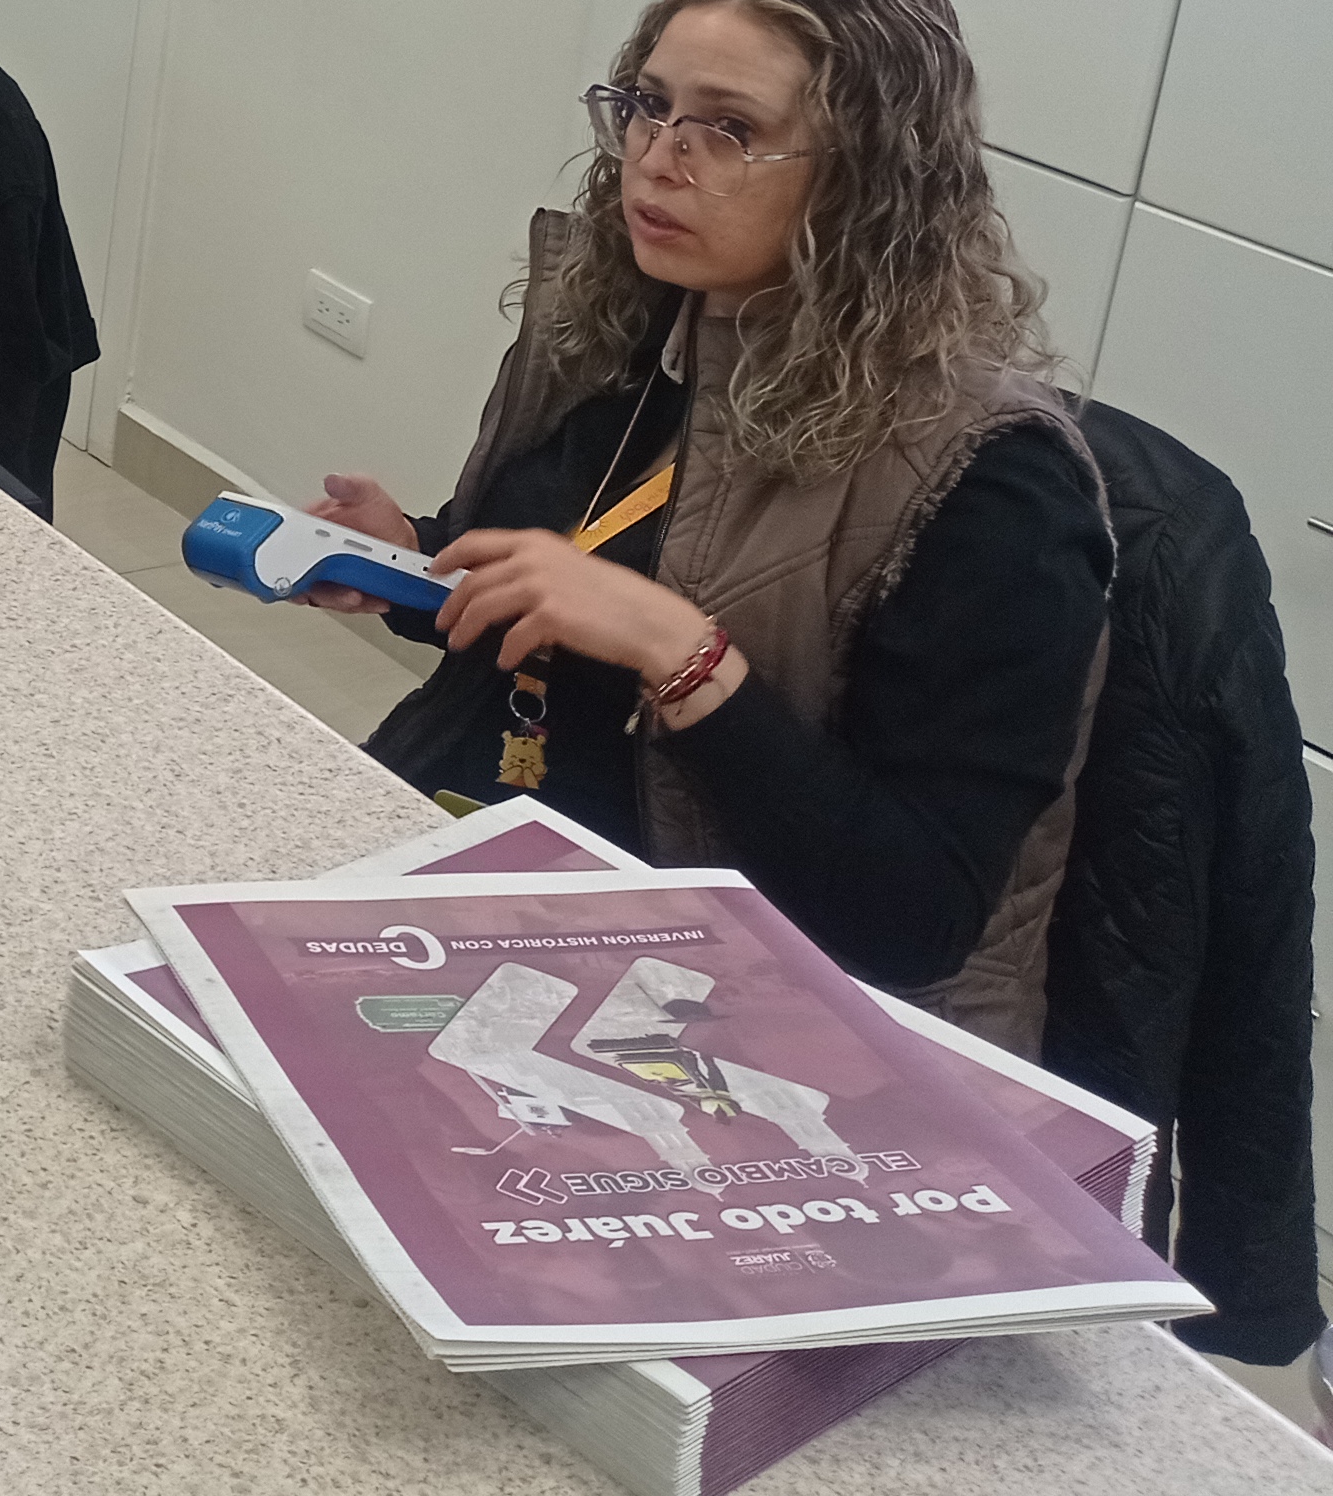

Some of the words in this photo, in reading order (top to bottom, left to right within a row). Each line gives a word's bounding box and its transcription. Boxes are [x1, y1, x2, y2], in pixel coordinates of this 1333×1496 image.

[306, 942, 408, 953] DEUDAS
[450, 940, 494, 950] CON
[497, 936, 599, 949] HISTÓRICA
[603, 930, 705, 946] INVERSIÓN
[694, 1156, 860, 1186] CAMBIO
[857, 1151, 922, 1172] EL
[561, 1169, 693, 1195] SIGUE
[889, 1185, 1012, 1216] Por
[720, 1198, 881, 1234] todo
[481, 1211, 715, 1249] Juárez
